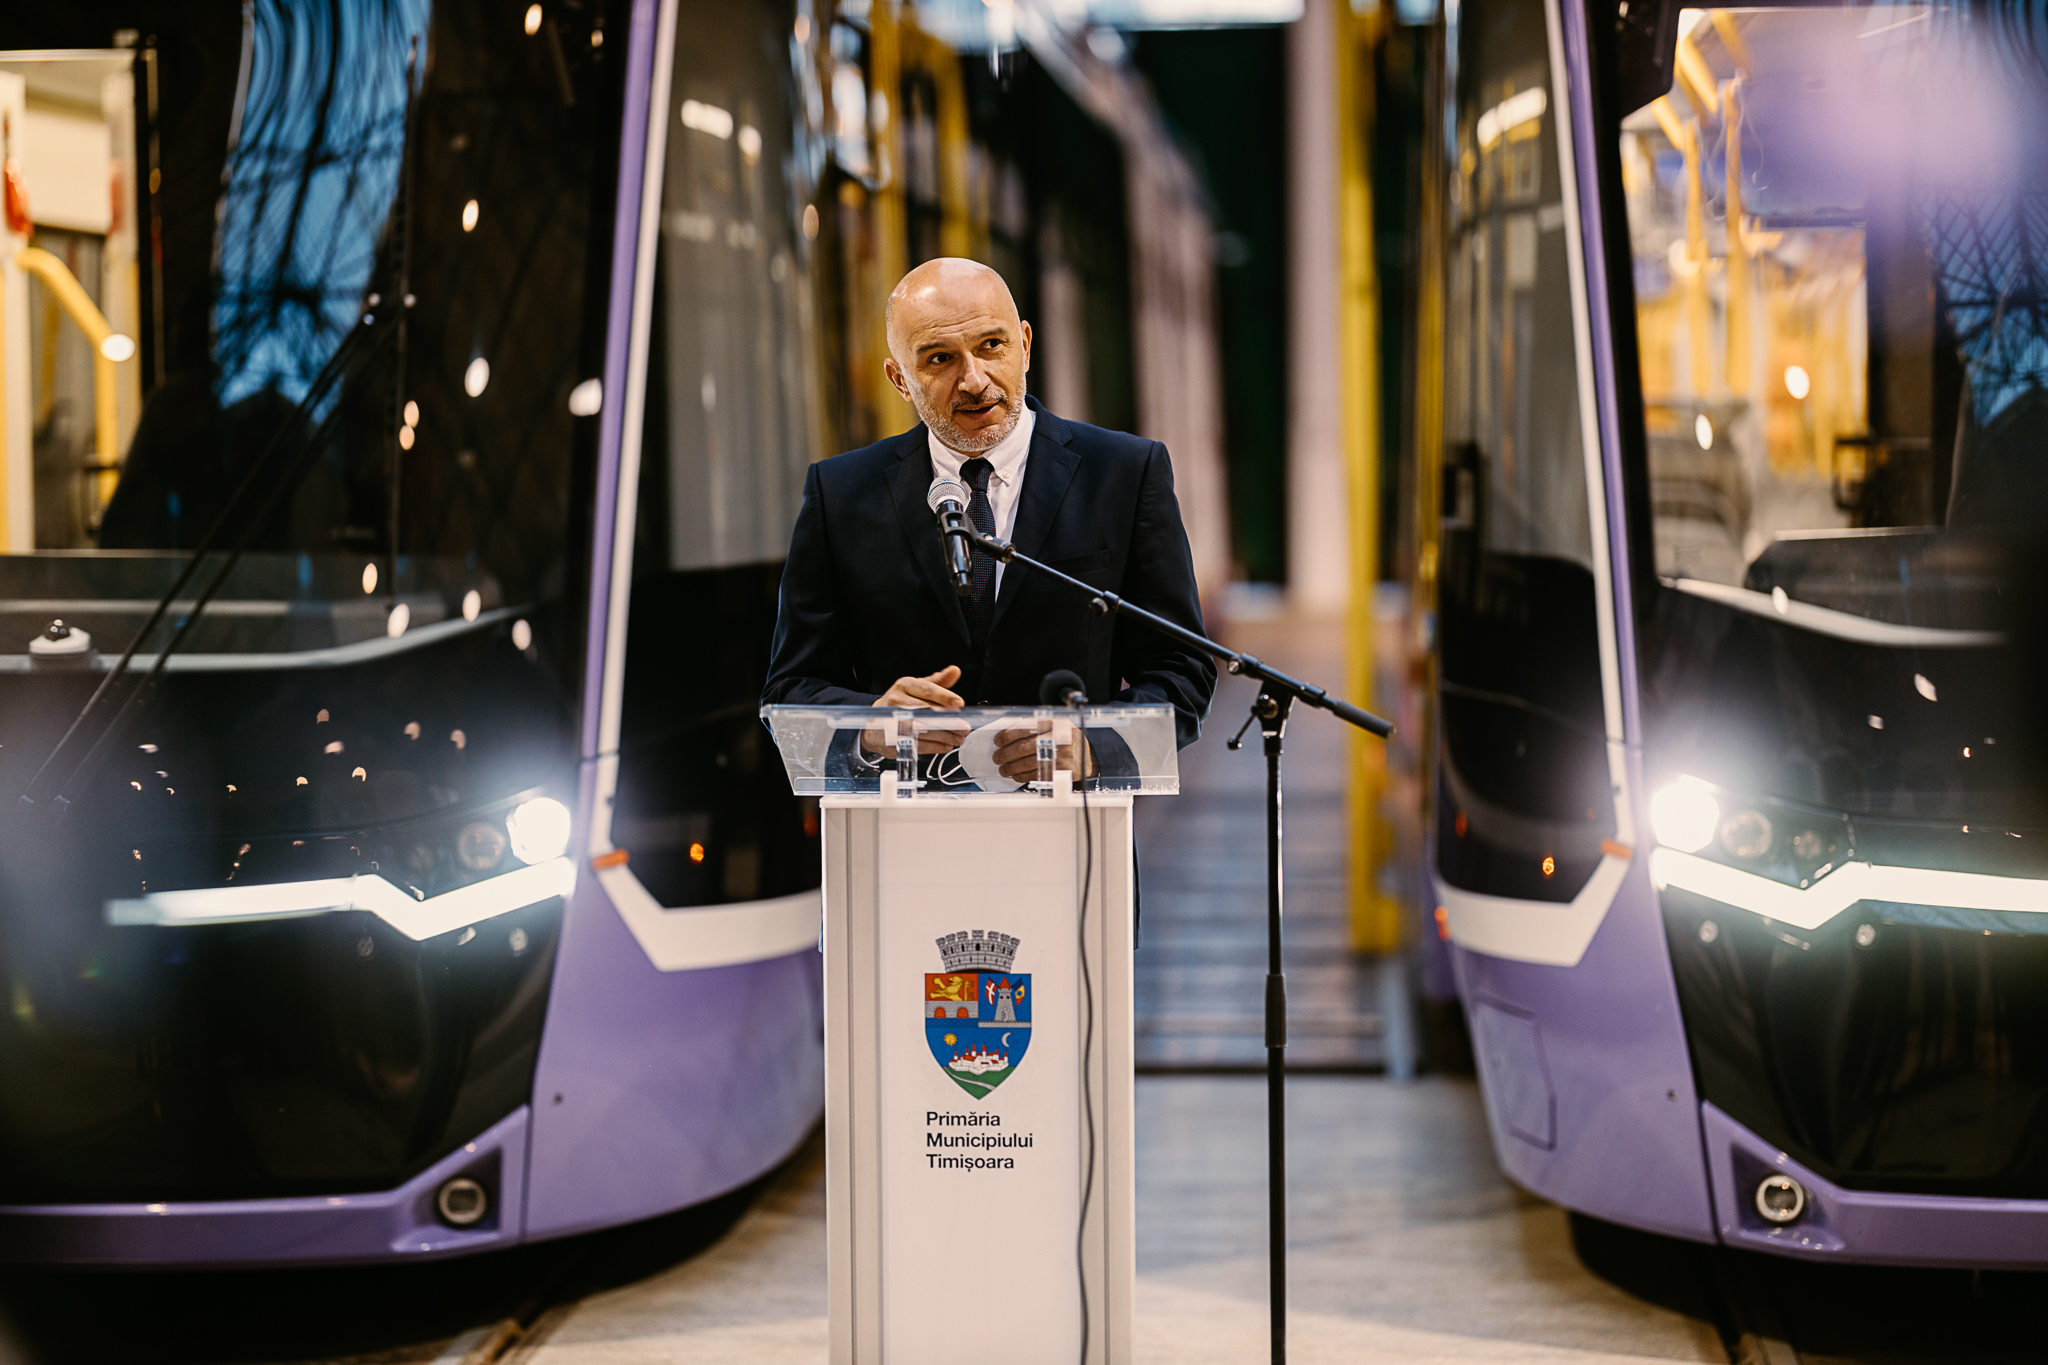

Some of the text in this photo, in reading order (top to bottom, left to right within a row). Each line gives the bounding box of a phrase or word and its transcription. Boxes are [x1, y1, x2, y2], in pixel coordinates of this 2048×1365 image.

[926, 1111, 1001, 1126] Primăria
[926, 1132, 1033, 1151] Municipiului
[926, 1153, 1014, 1173] Timișoara
